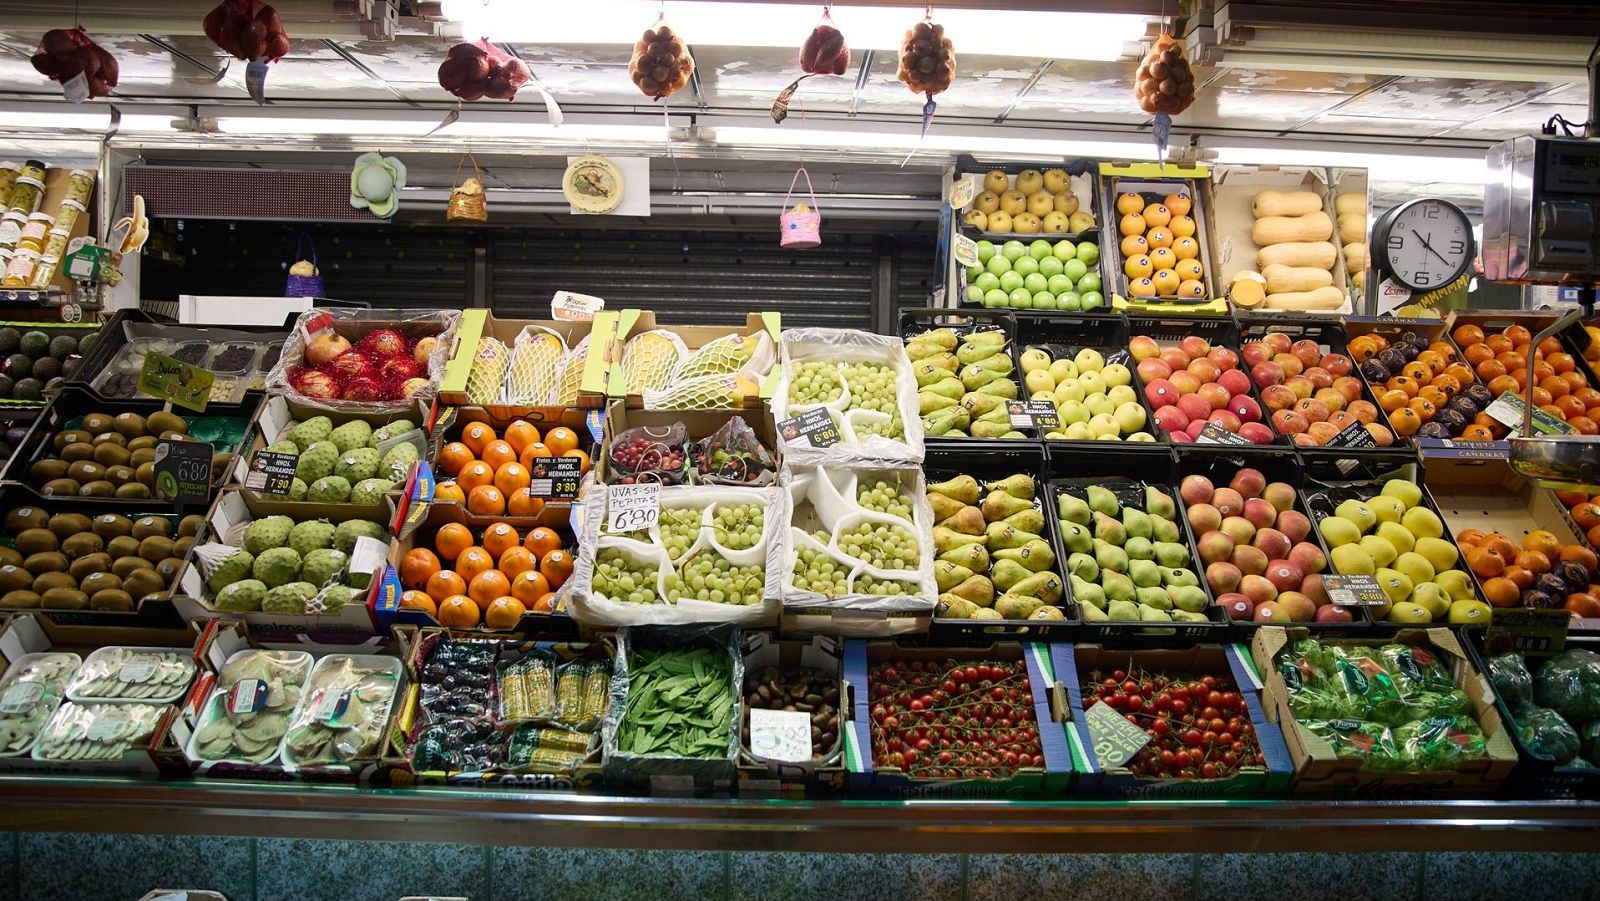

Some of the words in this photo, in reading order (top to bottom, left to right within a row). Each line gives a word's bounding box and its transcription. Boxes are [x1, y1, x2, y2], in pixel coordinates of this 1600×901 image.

[1423, 204, 1440, 218] 12
[1388, 236, 1403, 249] 9
[1449, 240, 1464, 254] 3
[1392, 256, 1398, 264] 8
[1414, 271, 1429, 285] 6
[814, 429, 835, 443] 6'80
[178, 460, 208, 481] 6'80
[265, 465, 295, 475] HERNANDEZ
[270, 478, 290, 489] 7'90
[555, 482, 576, 492] 3'80
[610, 496, 656, 508] PEPITAS
[615, 509, 656, 529] 6'80
